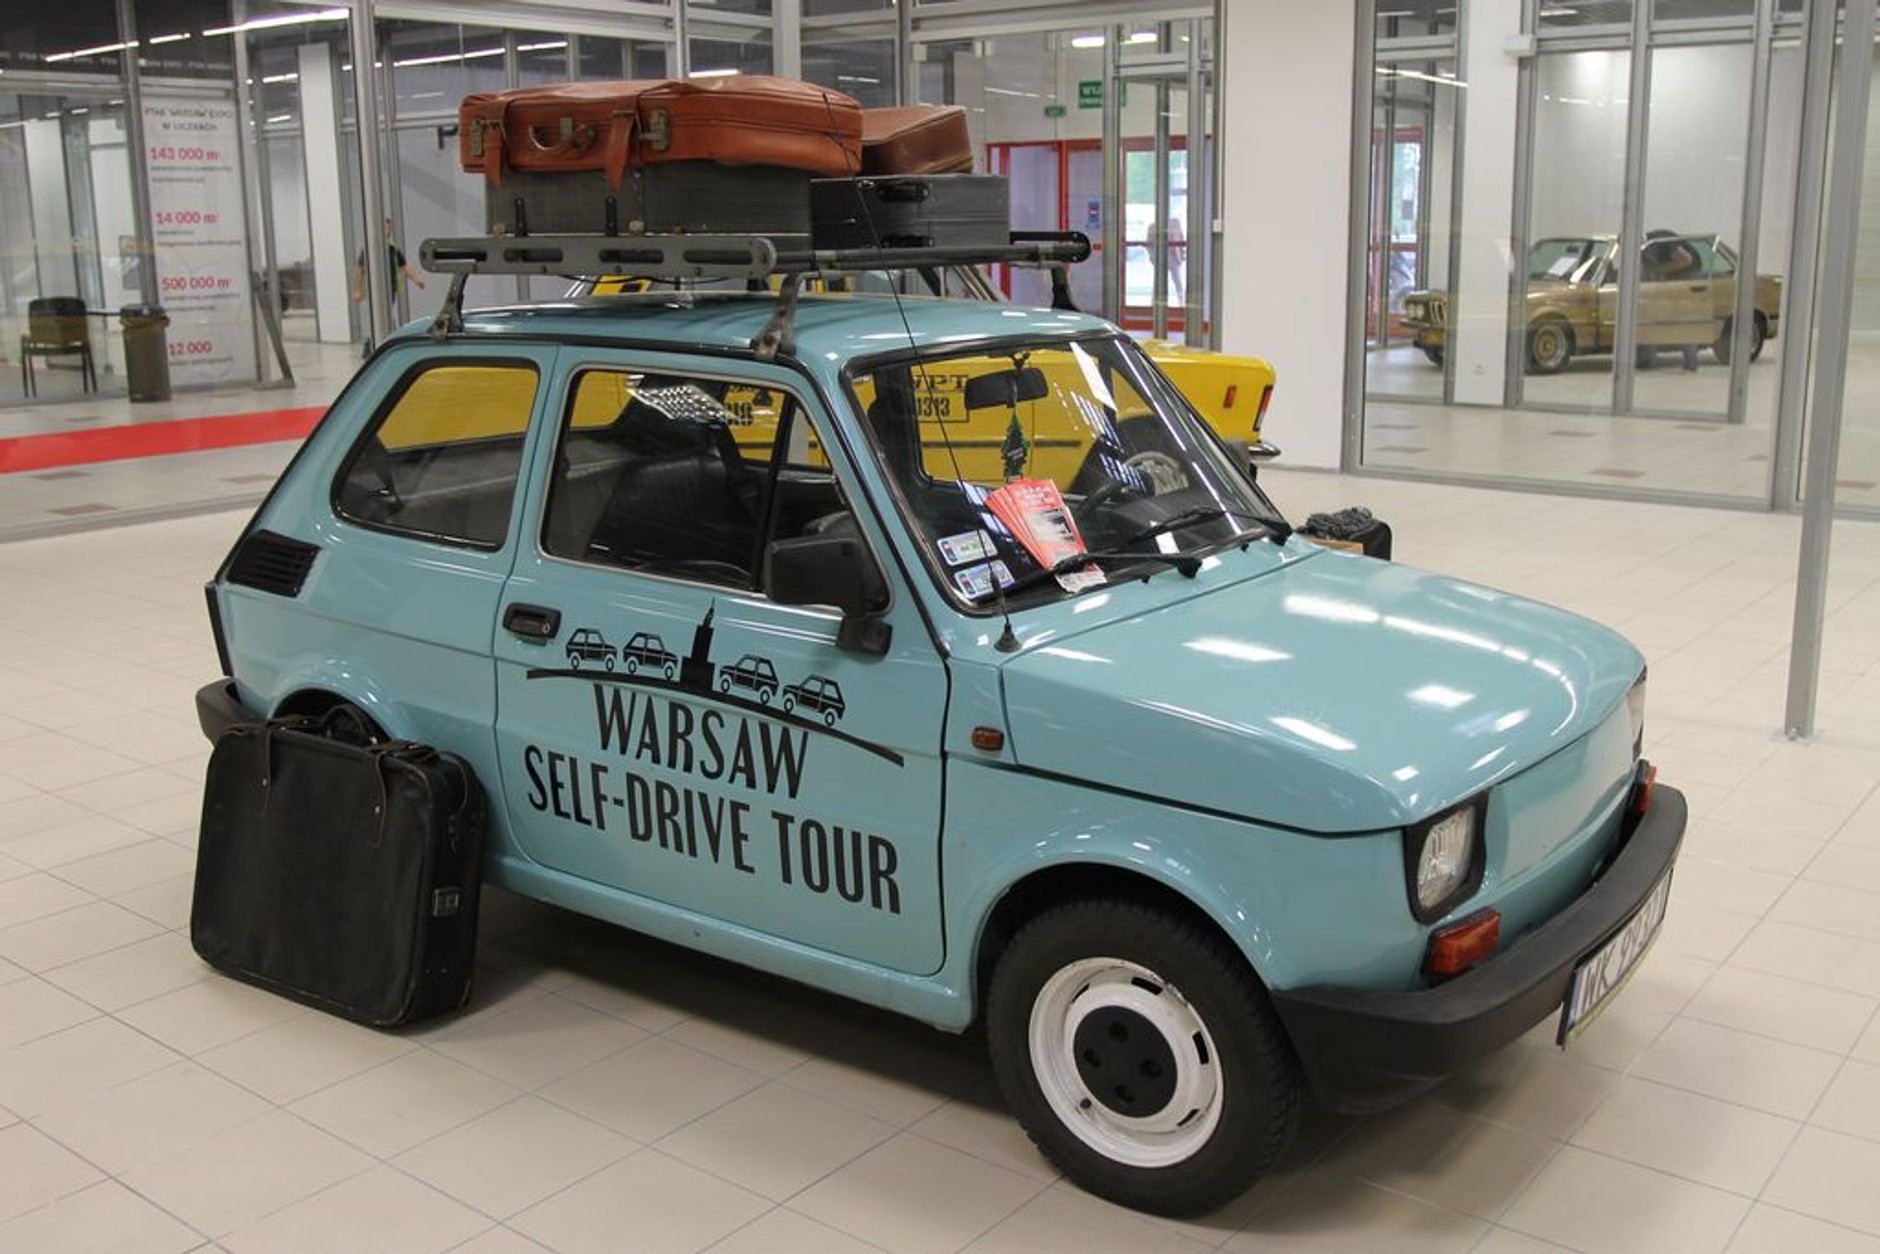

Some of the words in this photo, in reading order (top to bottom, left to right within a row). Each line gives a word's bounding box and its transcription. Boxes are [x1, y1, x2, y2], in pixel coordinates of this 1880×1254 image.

[150, 147, 175, 160] 143
[178, 147, 203, 161] 000
[156, 212, 173, 225] 14
[175, 211, 200, 224] 000
[162, 278, 187, 290] 500
[190, 277, 214, 289] 000
[187, 341, 212, 354] 000
[594, 683, 809, 800] WARSAW
[524, 744, 756, 875] SELF-DRIVE
[771, 809, 901, 914] TOUR
